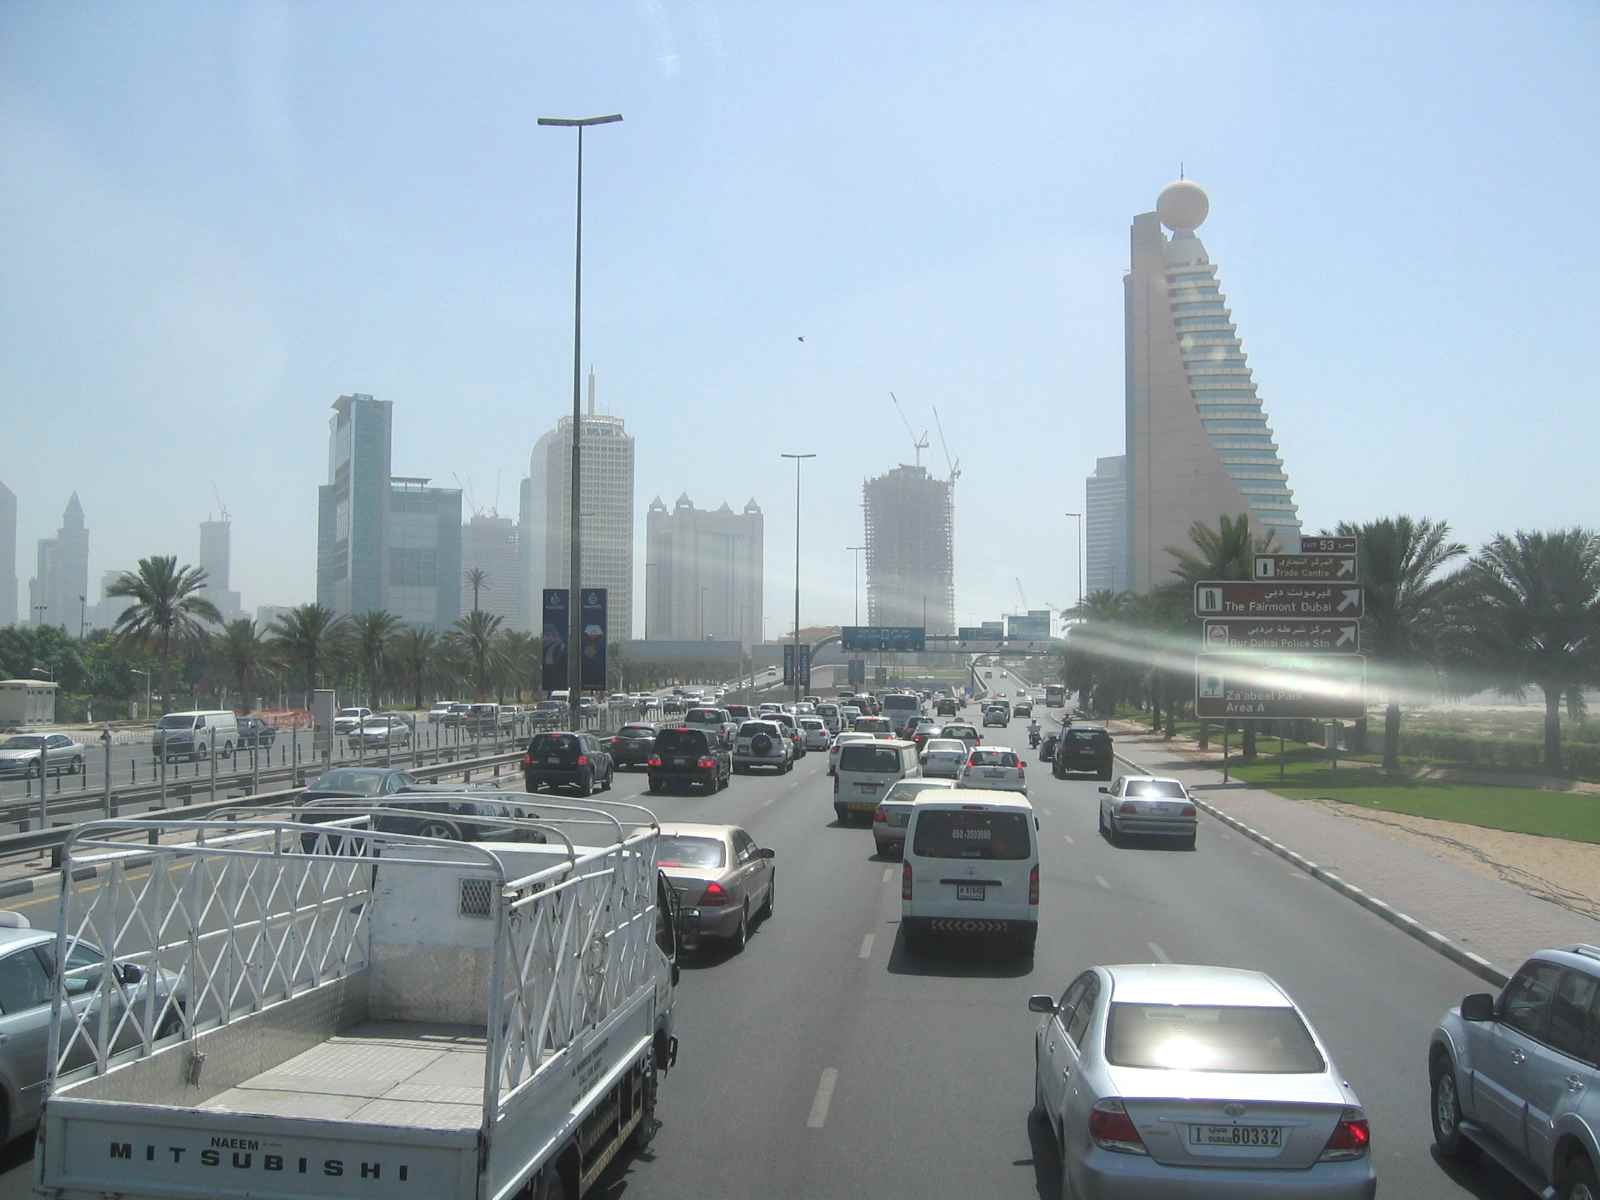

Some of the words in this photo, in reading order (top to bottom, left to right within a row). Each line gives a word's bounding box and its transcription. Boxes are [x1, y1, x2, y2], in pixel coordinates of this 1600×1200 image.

[1320, 541, 1334, 551] 53
[1277, 567, 1297, 576] Trade
[1302, 567, 1329, 576] Centre
[1225, 600, 1245, 611] The
[1249, 600, 1296, 611] Fairmont
[1300, 600, 1332, 611] Dubai
[1281, 639, 1311, 648] Police
[1313, 639, 1330, 648] Stn
[1225, 702, 1254, 712] Area
[1257, 702, 1265, 712] A
[211, 1136, 259, 1151] NAEEM
[109, 1141, 408, 1181] MITSUBISHI
